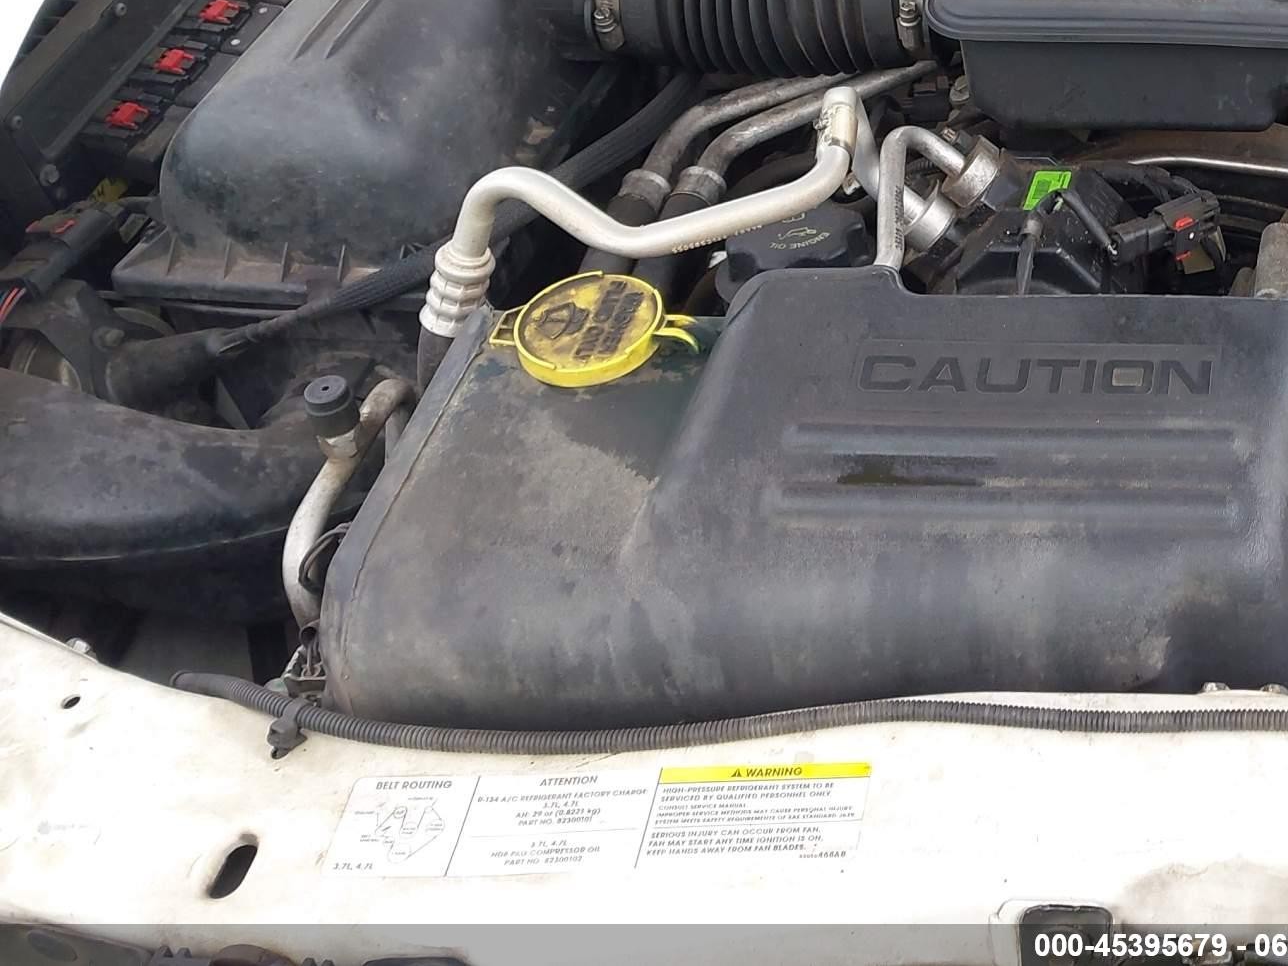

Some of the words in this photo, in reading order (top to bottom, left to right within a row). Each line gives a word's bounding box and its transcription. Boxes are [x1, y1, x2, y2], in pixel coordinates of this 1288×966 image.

[769, 242, 787, 250] OIL
[789, 232, 831, 250] ENGINE
[857, 354, 1214, 395] CAUTION
[746, 766, 803, 778] WARNING
[376, 781, 401, 790] BELT
[402, 780, 454, 789] ROUTING
[539, 775, 599, 786] ATTENTION
[662, 785, 725, 793] HIGH-PRESSURE
[727, 784, 779, 792] REFRIGERANT
[781, 782, 811, 790] SYSTEM
[812, 782, 823, 790] TO
[520, 792, 572, 801] REFRIGERANT
[573, 790, 611, 799] FACTORY
[612, 788, 648, 796] CHARGE
[660, 794, 701, 802] SERVICED
[702, 794, 714, 802] BY
[716, 793, 758, 801] QUALIFIED
[760, 791, 806, 799] PERSONNEL
[517, 819, 538, 827] PART
[651, 830, 686, 838] SERIOUS
[687, 829, 718, 837] INJURY
[742, 827, 774, 835] OCCUR
[648, 840, 666, 848] FAN
[667, 839, 686, 847] MAY
[687, 838, 714, 846] START
[756, 836, 796, 844] IGNITION
[529, 847, 586, 856] COMPRESSOR
[587, 845, 601, 853] OIL
[646, 849, 667, 857] KEEP
[700, 846, 725, 854] AWAY
[727, 845, 752, 853] FROM
[753, 844, 771, 852] FAN
[356, 862, 374, 870] 4.7L
[503, 859, 525, 867] PART
